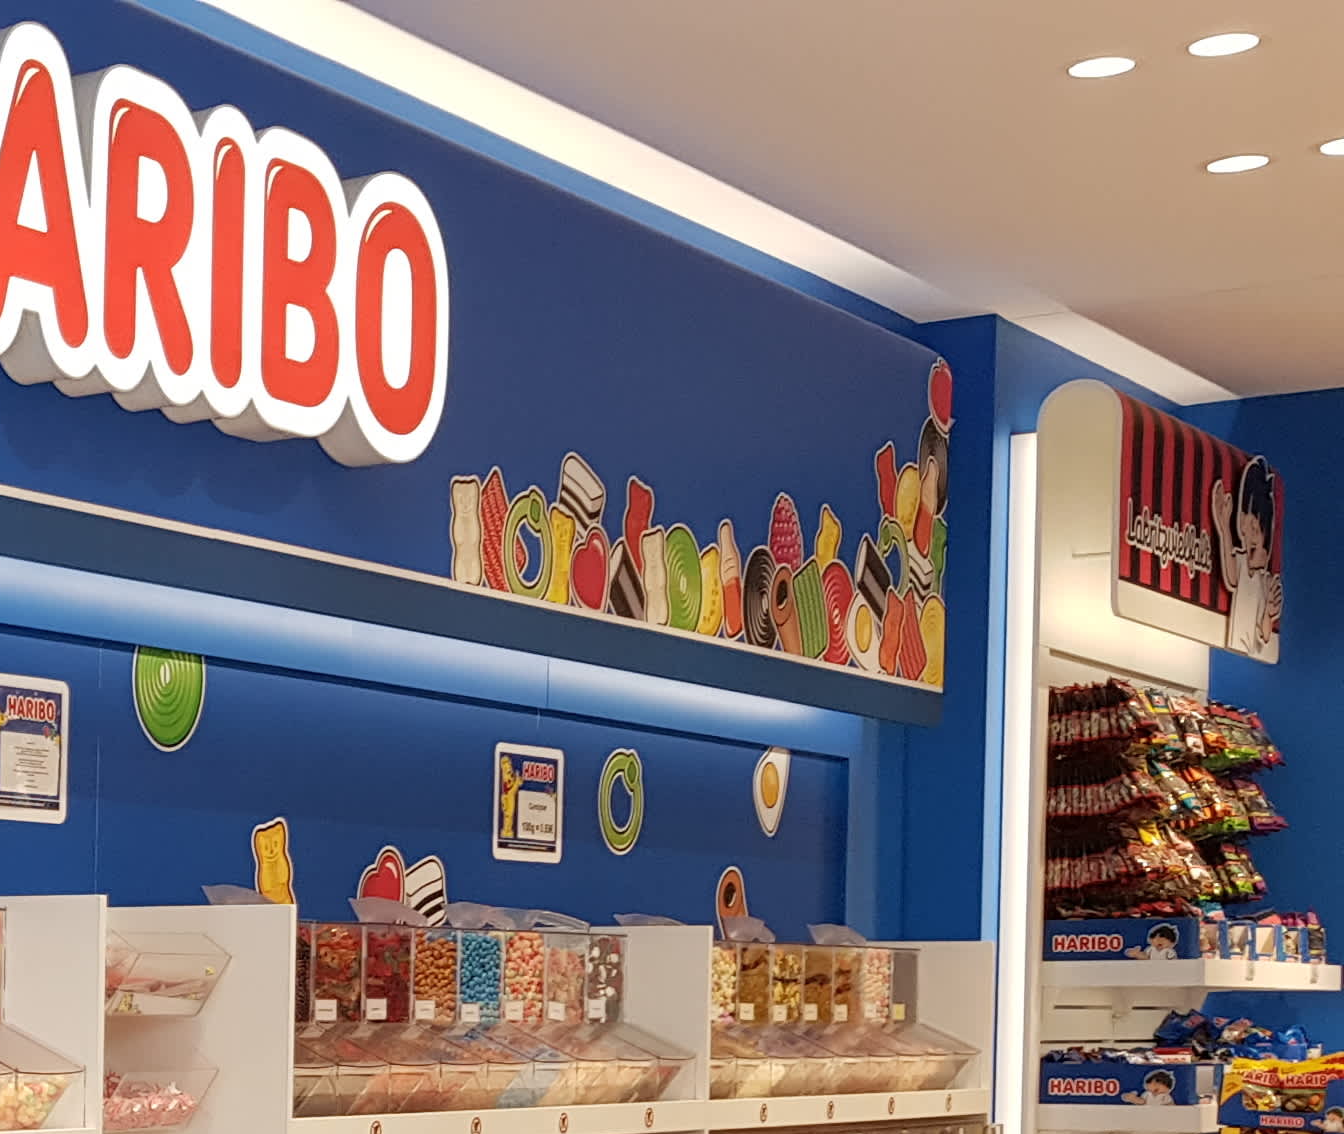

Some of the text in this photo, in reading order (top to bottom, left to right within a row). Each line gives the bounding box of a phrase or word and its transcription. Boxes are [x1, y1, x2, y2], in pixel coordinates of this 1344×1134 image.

[1124, 497, 1212, 579] Lakritzvielfalt
[7, 695, 56, 722] HARIBO
[1053, 934, 1123, 952] HARIBO
[1048, 1078, 1120, 1096] HARIBO
